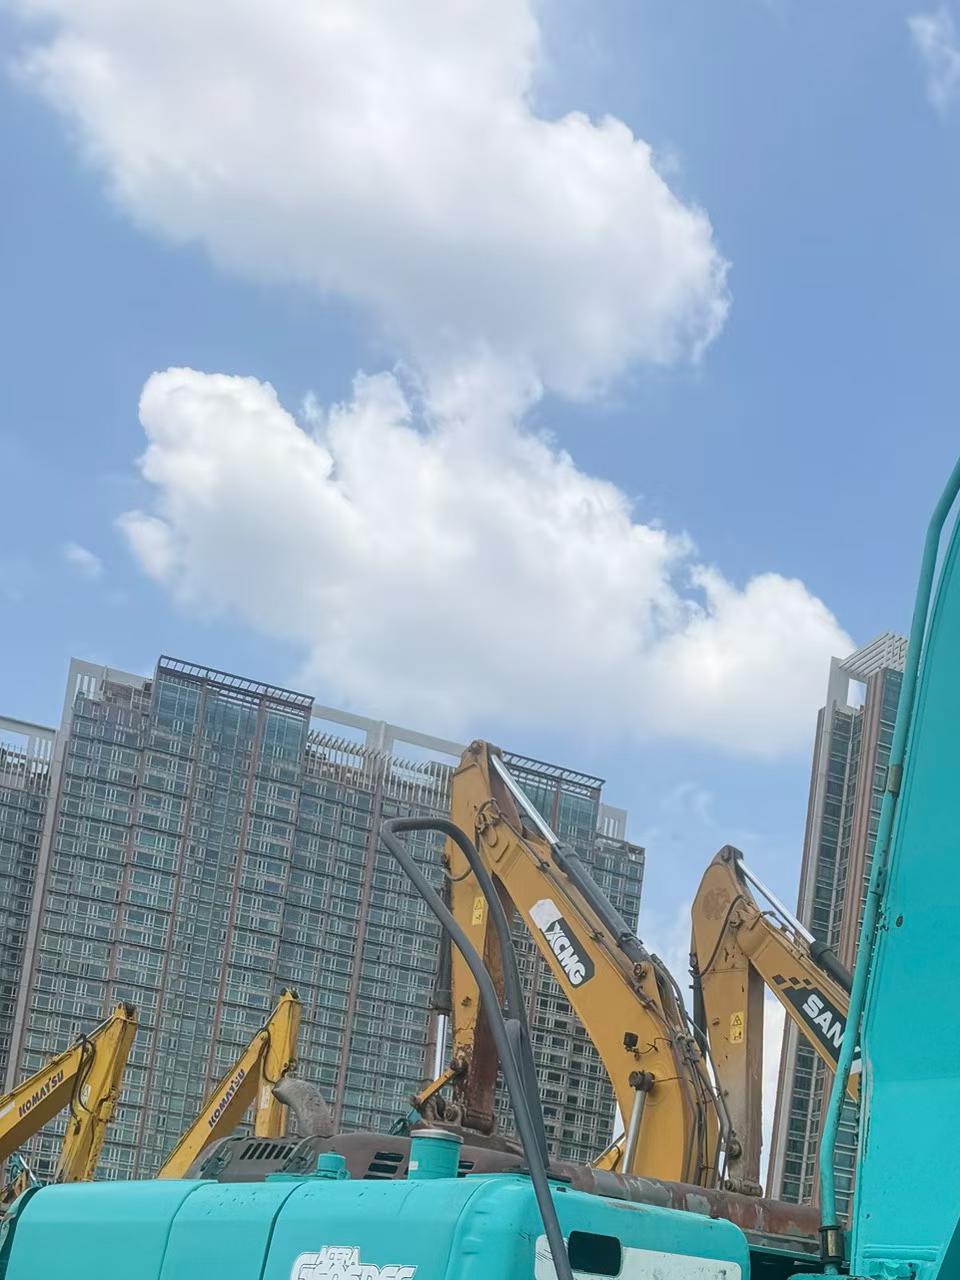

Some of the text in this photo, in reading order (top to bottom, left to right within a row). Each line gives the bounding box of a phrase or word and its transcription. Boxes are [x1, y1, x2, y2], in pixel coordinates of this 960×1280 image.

[544, 921, 586, 985] XCMG
[802, 993, 861, 1053] SAN
[18, 1069, 64, 1118] KOMATSU
[208, 1069, 245, 1128] KOMATSU
